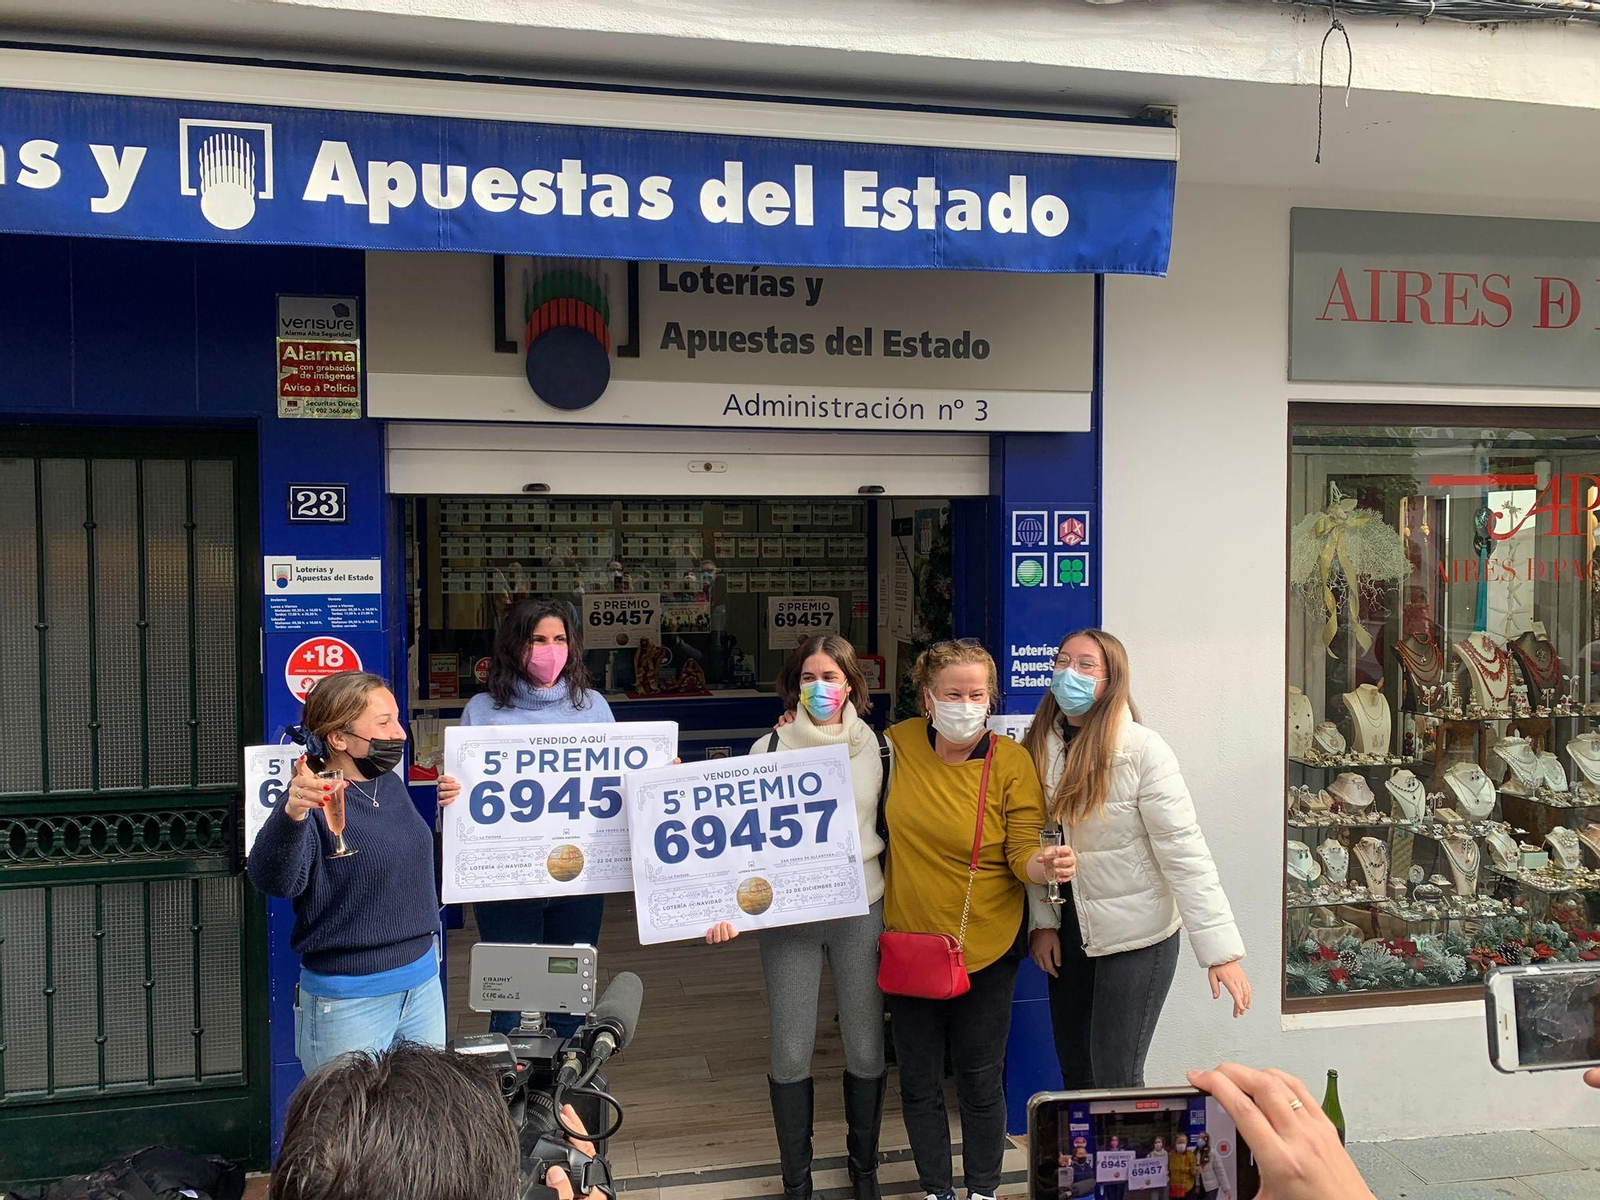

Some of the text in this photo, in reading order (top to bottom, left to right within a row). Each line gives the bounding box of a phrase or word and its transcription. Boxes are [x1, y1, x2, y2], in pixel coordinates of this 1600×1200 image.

[88, 144, 147, 213] y
[302, 140, 675, 224] Apuestas
[700, 161, 813, 227] del
[843, 170, 1070, 238] Estado
[658, 264, 824, 307] Loterías y
[1315, 267, 1513, 328] AIRES
[281, 318, 354, 330] verisure
[322, 330, 352, 338] Seguridad
[660, 321, 990, 360] Apuestas del Estado
[282, 345, 356, 362] Alarma
[316, 364, 355, 373] grabación
[313, 372, 355, 382] imágenes
[283, 383, 311, 392] Aviso
[323, 383, 356, 393] Policía
[723, 393, 988, 421] Administración nº 3
[296, 491, 340, 516] 23
[296, 565, 327, 573] Loterías
[604, 600, 650, 609] PREMIO
[787, 602, 830, 611] PREMIO
[589, 610, 655, 626] 69457
[774, 612, 834, 627] 69457
[302, 644, 344, 668] +18
[1011, 643, 1059, 657] Loterías
[1011, 674, 1052, 688] Estado
[529, 734, 607, 745] VENDIDO AQUÍ
[516, 746, 648, 774] PREMIO
[703, 763, 778, 781] VENDIDO AQUÍ
[693, 771, 823, 811] PREMIO
[469, 776, 623, 825] 6945
[653, 798, 838, 864] 69457
[802, 884, 832, 892] DICIEMBRE
[662, 903, 687, 911] LOTERÍA
[1101, 1160, 1127, 1169] 6945
[1132, 1166, 1162, 1176] 69457
